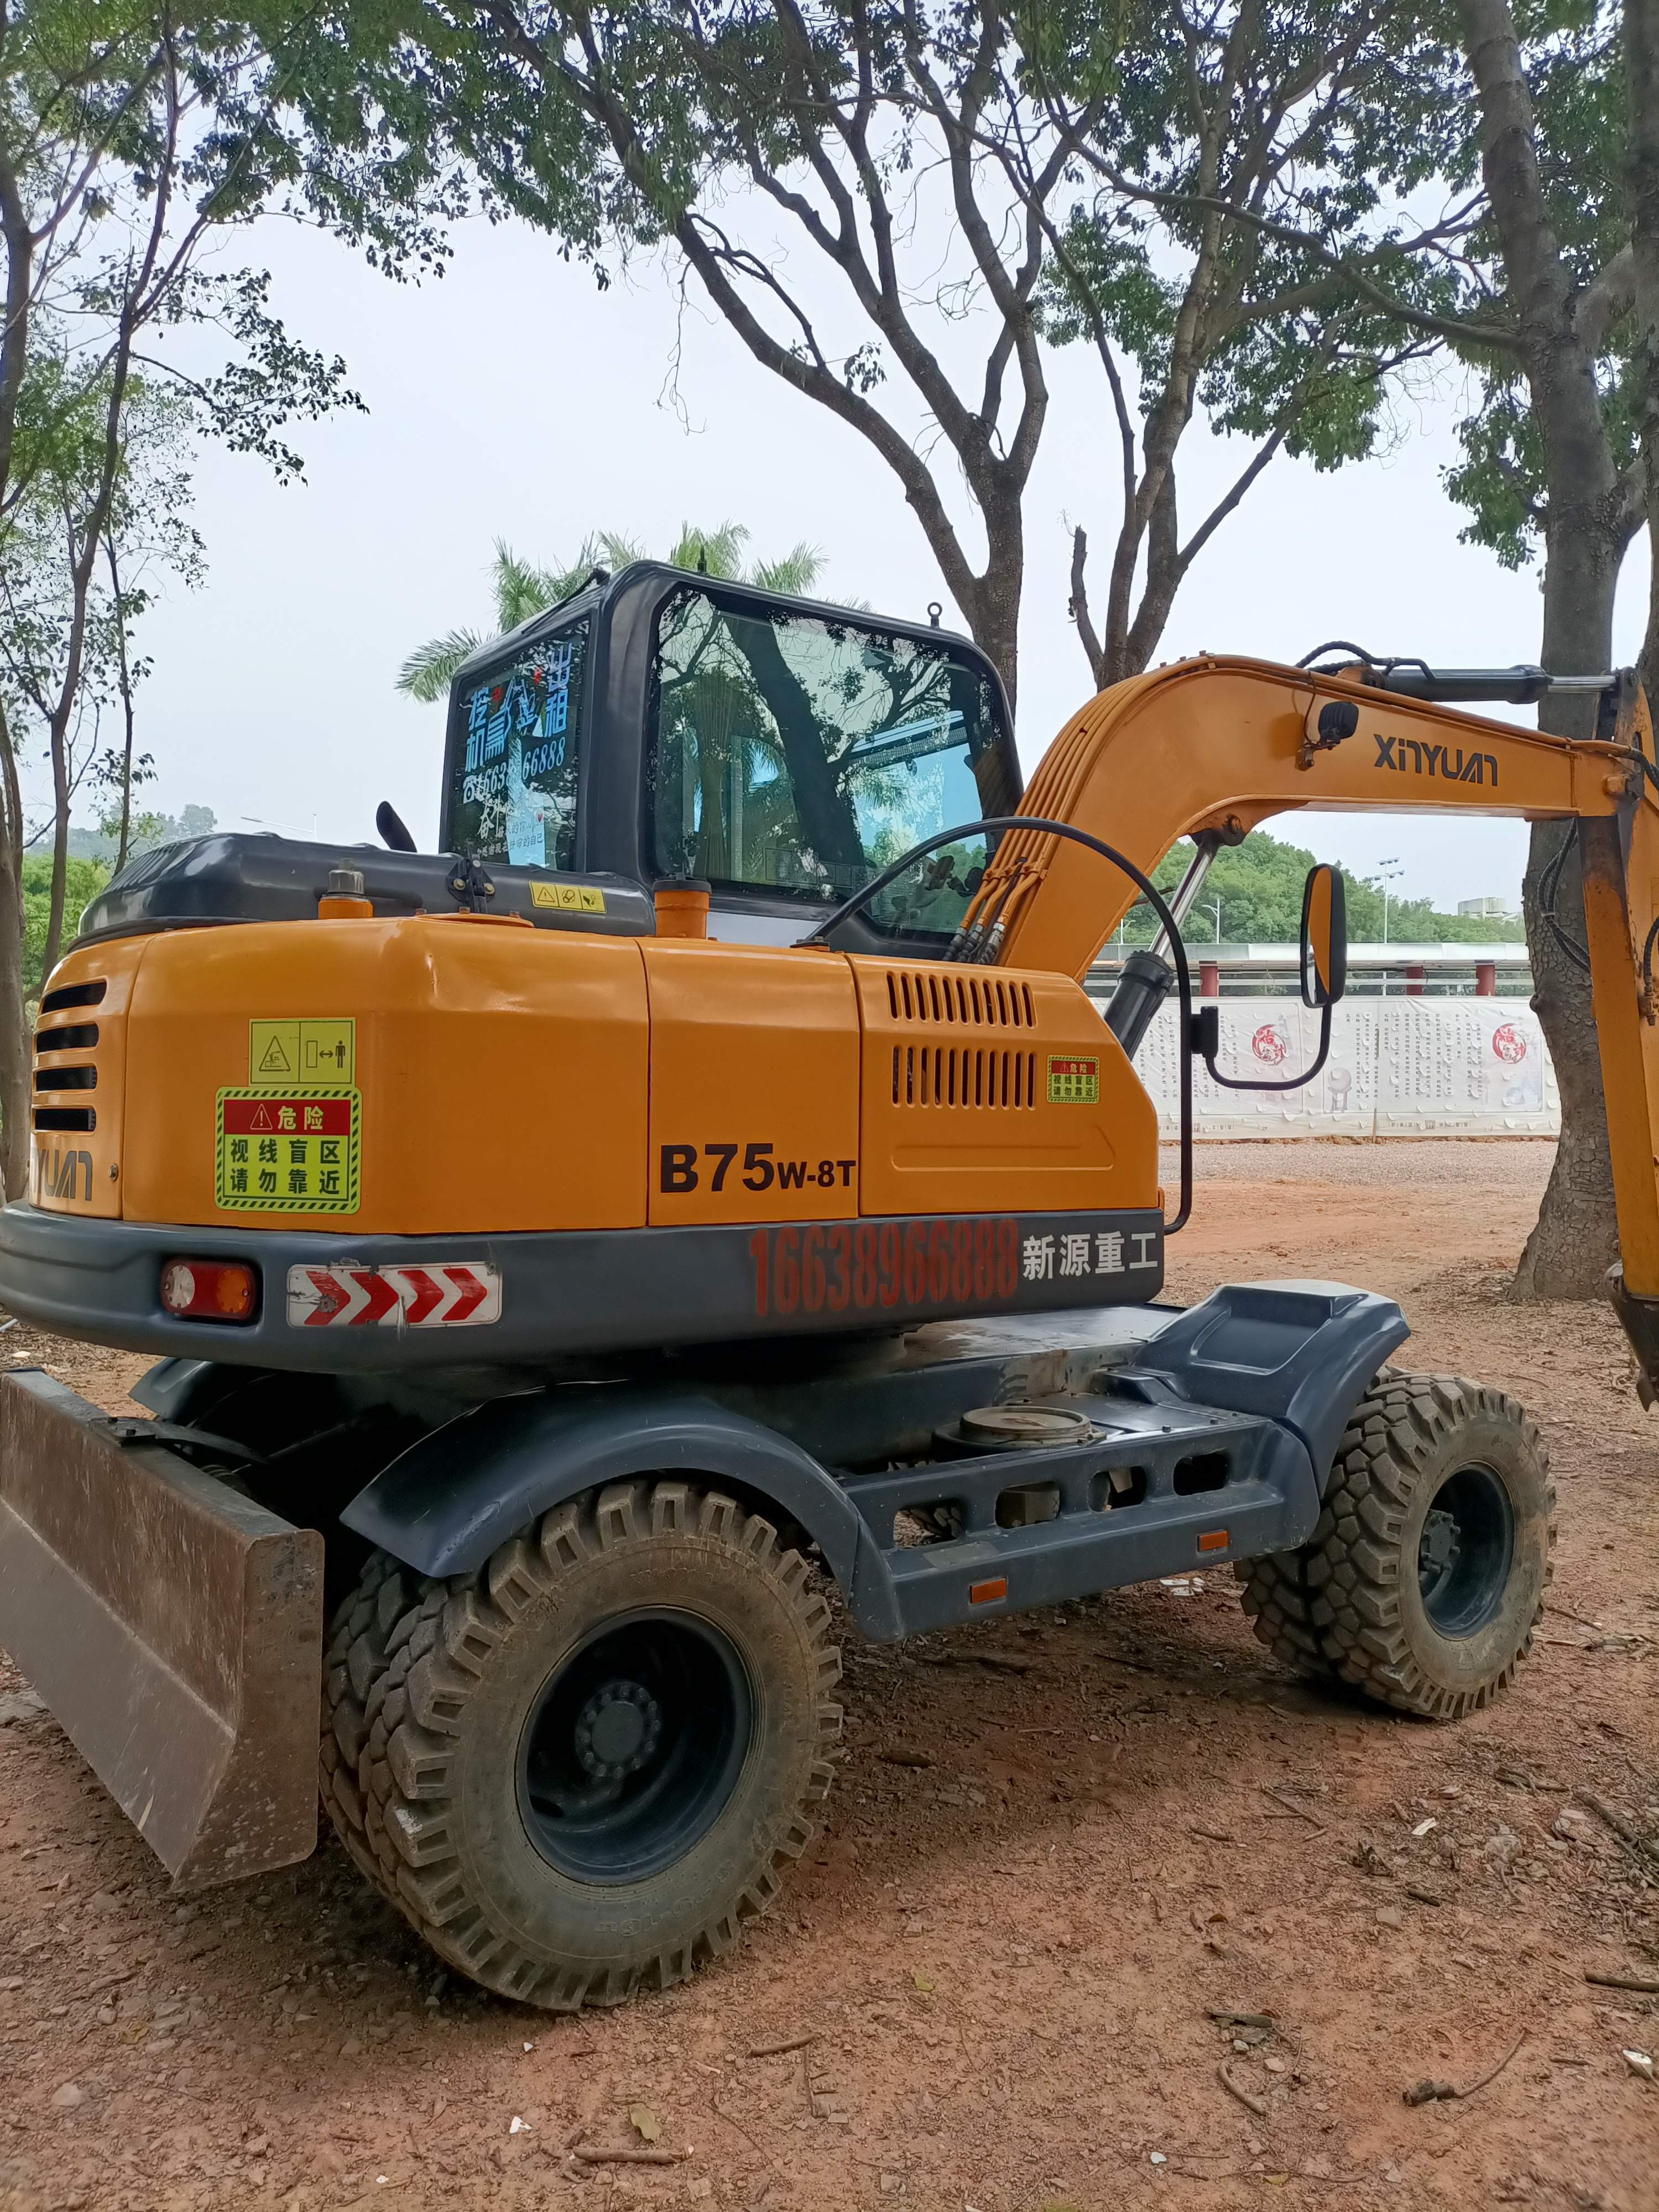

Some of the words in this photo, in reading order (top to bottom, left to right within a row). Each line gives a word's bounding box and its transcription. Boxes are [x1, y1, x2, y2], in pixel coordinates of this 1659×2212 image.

[545, 642, 572, 738] 出租
[465, 686, 489, 772] 挖机
[1053, 1074, 1093, 1085] 视线盲区
[1070, 1063, 1088, 1073] 危险
[1053, 1086, 1093, 1097] 请勿靠近
[278, 1105, 324, 1130] 危险
[230, 1139, 341, 1164] 视线盲区
[230, 1167, 340, 1195] 请勿靠近
[749, 1219, 1019, 1317] 16638966888
[1022, 1230, 1158, 1281] 新源重工
